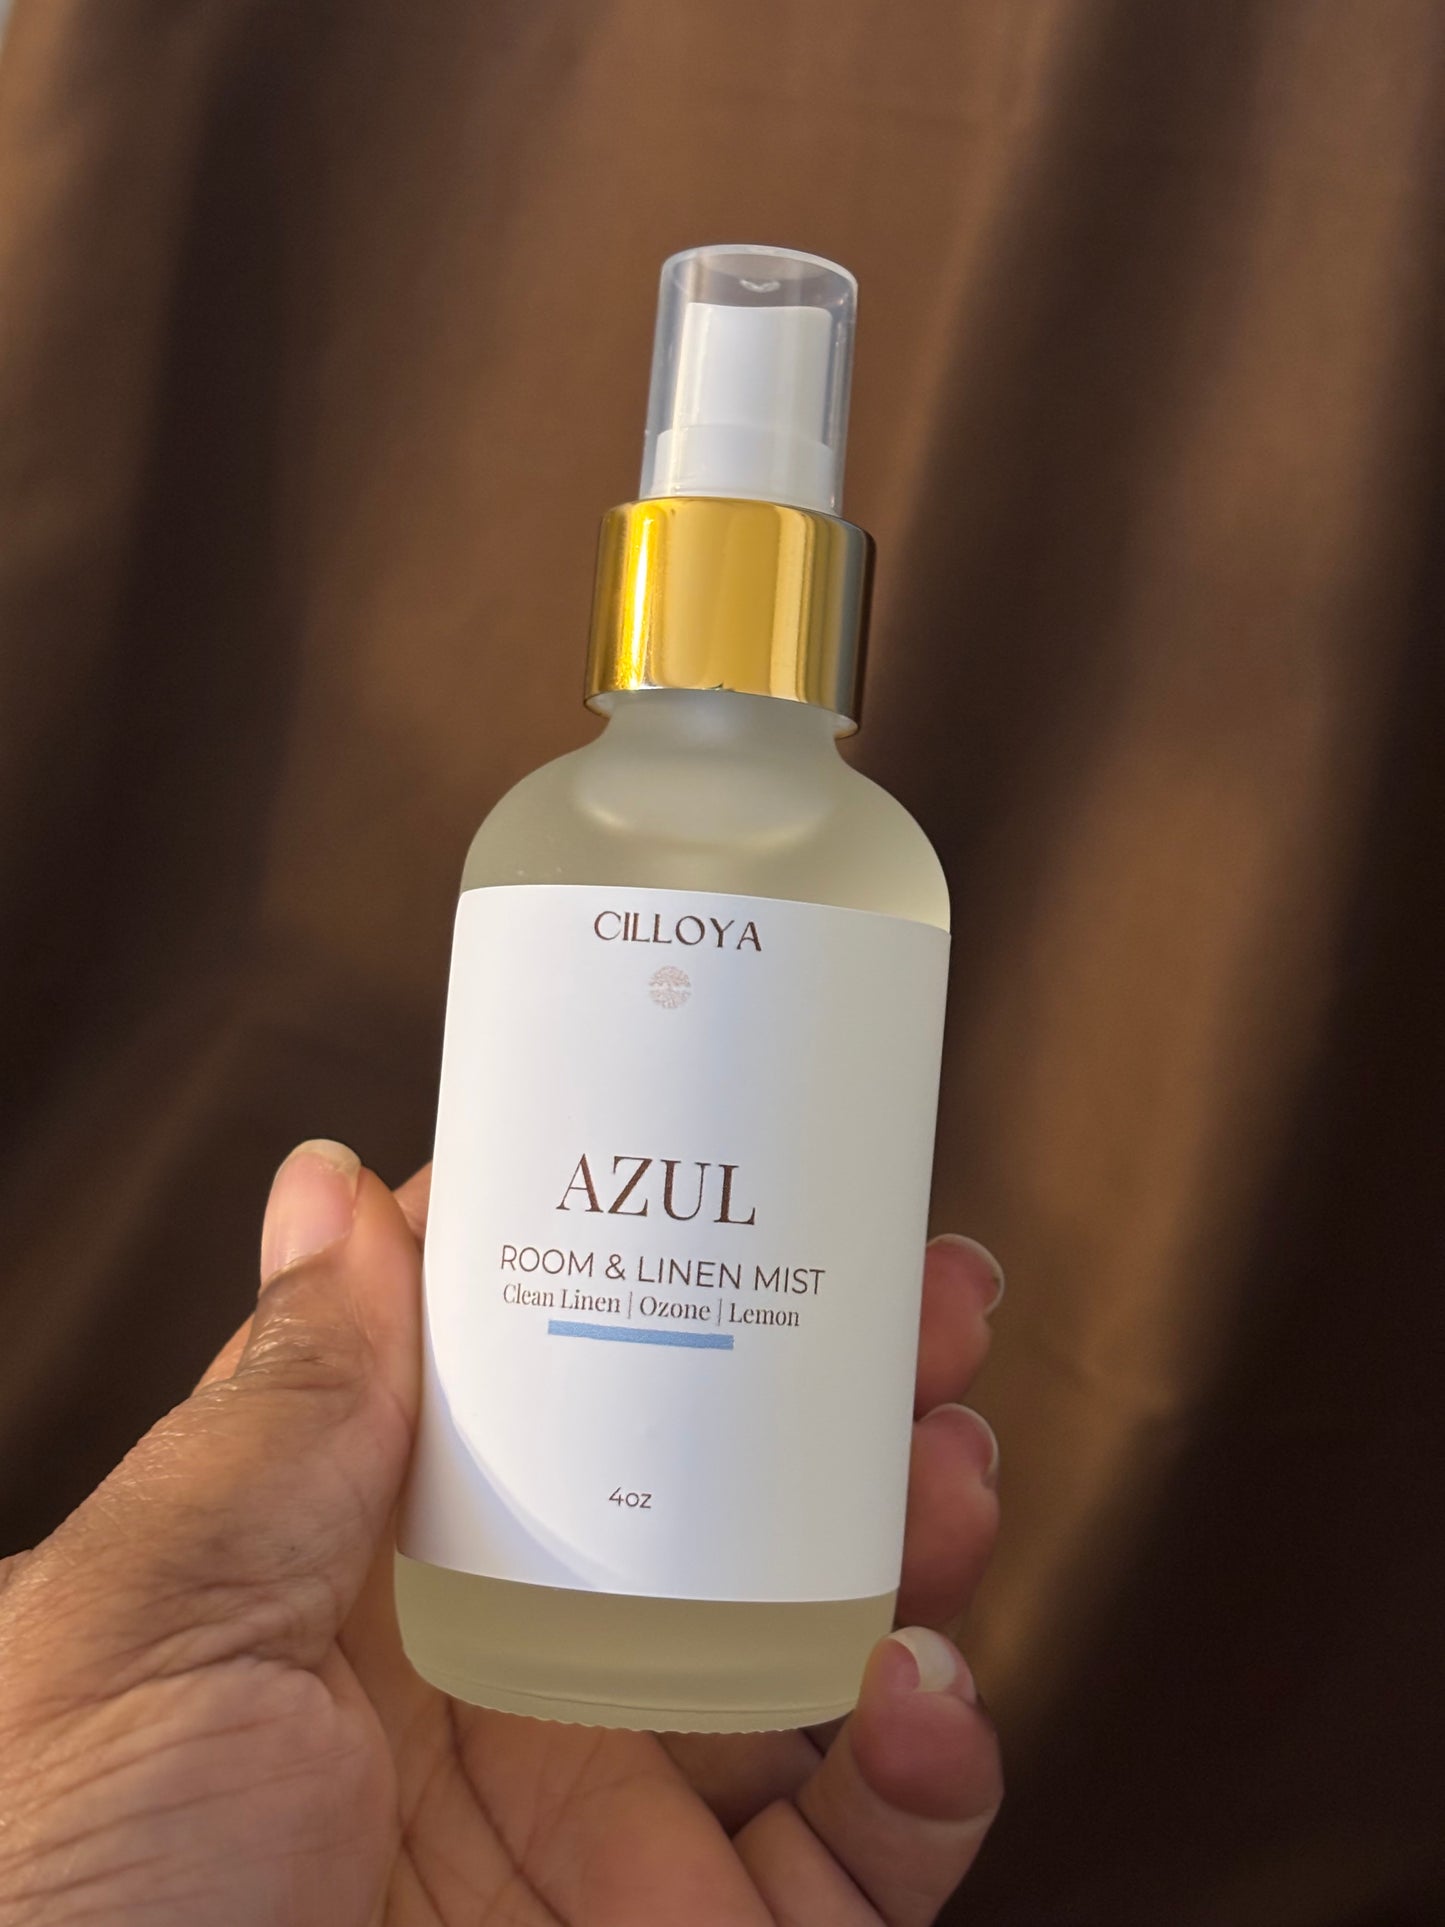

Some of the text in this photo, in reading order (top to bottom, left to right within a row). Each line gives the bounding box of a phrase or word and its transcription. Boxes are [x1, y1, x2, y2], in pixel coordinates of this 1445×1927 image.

[593, 910, 763, 952] CILLOYA
[555, 1152, 756, 1227] AZUL
[500, 1244, 827, 1296] ROOM & LINEN MIST
[502, 1282, 555, 1308] Clean
[559, 1288, 621, 1314] Linen
[639, 1295, 712, 1322] Ozone
[727, 1302, 800, 1328] Lemon
